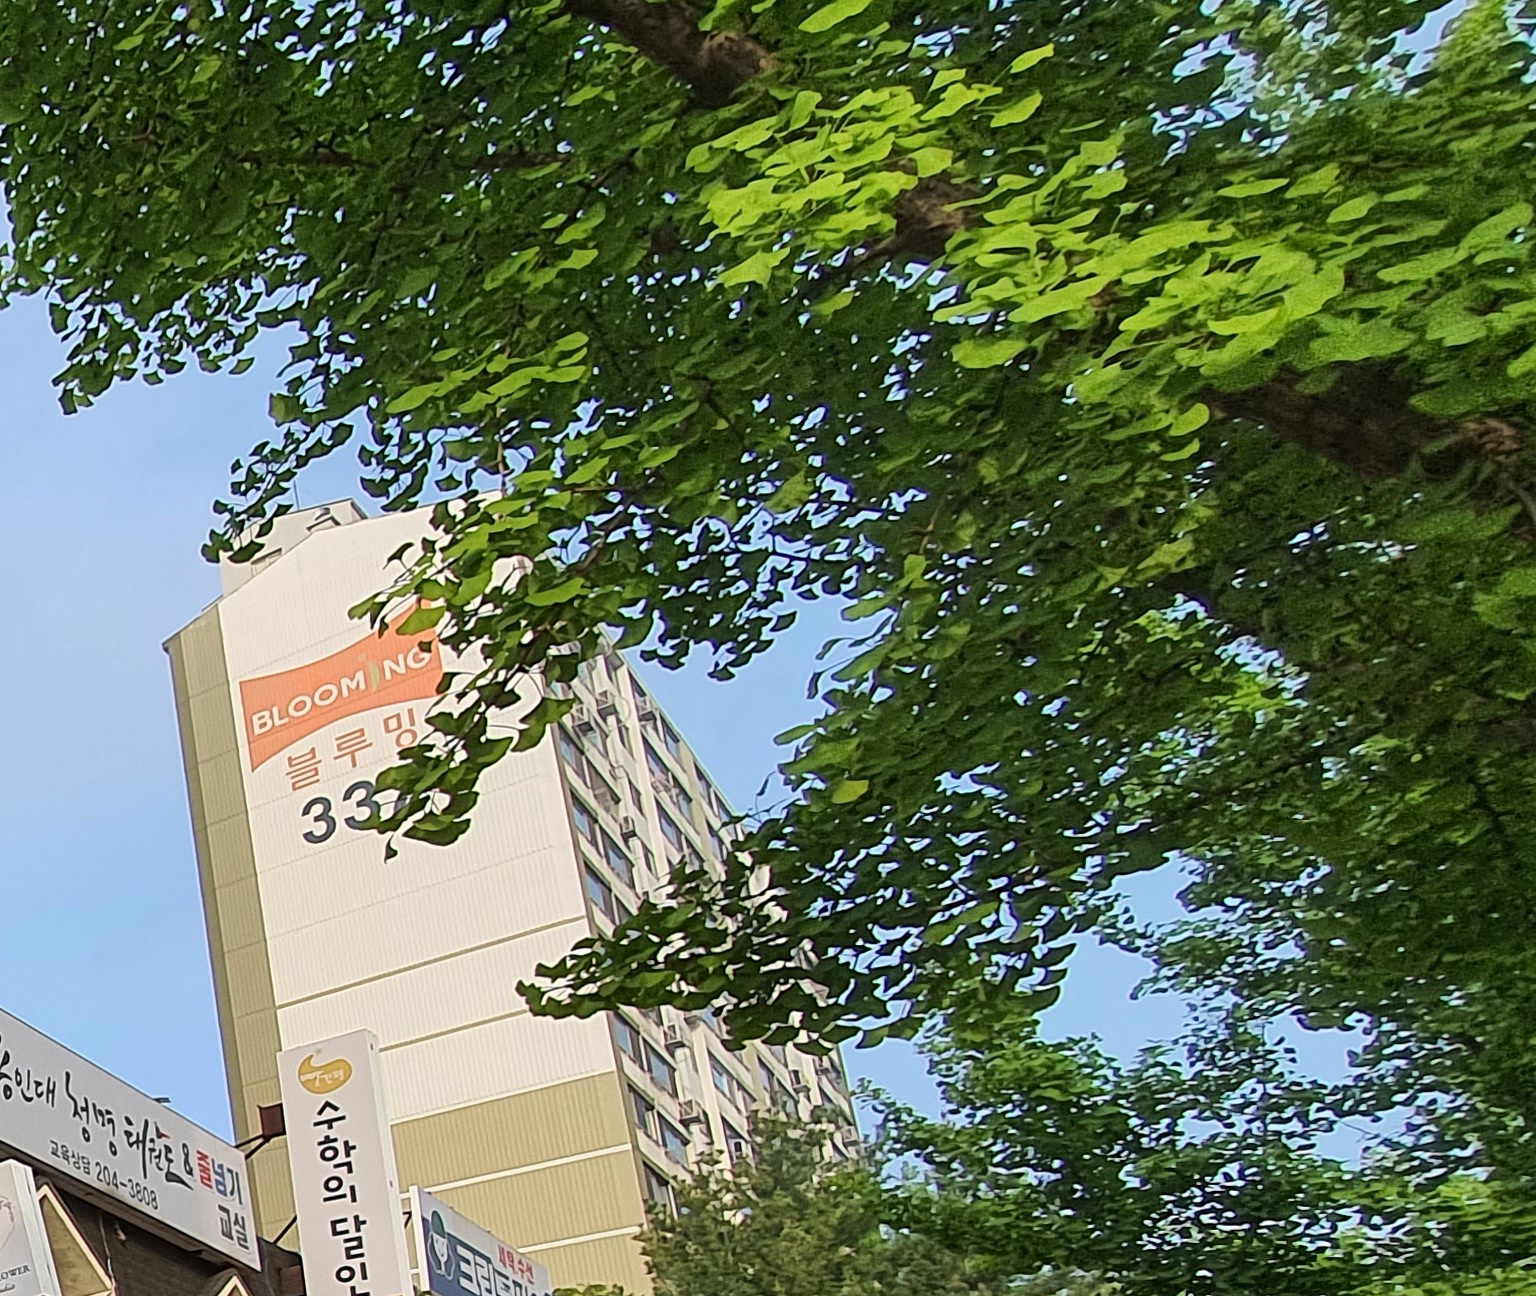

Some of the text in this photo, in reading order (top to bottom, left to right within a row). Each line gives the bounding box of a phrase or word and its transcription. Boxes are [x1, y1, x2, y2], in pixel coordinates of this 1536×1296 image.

[285, 707, 419, 792] 블루밍
[50, 1140, 158, 1210] 교육상담 204-3808
[196, 1149, 243, 1205] 줄넘기
[312, 1100, 358, 1204] 수학의
[218, 1204, 249, 1250] 교실
